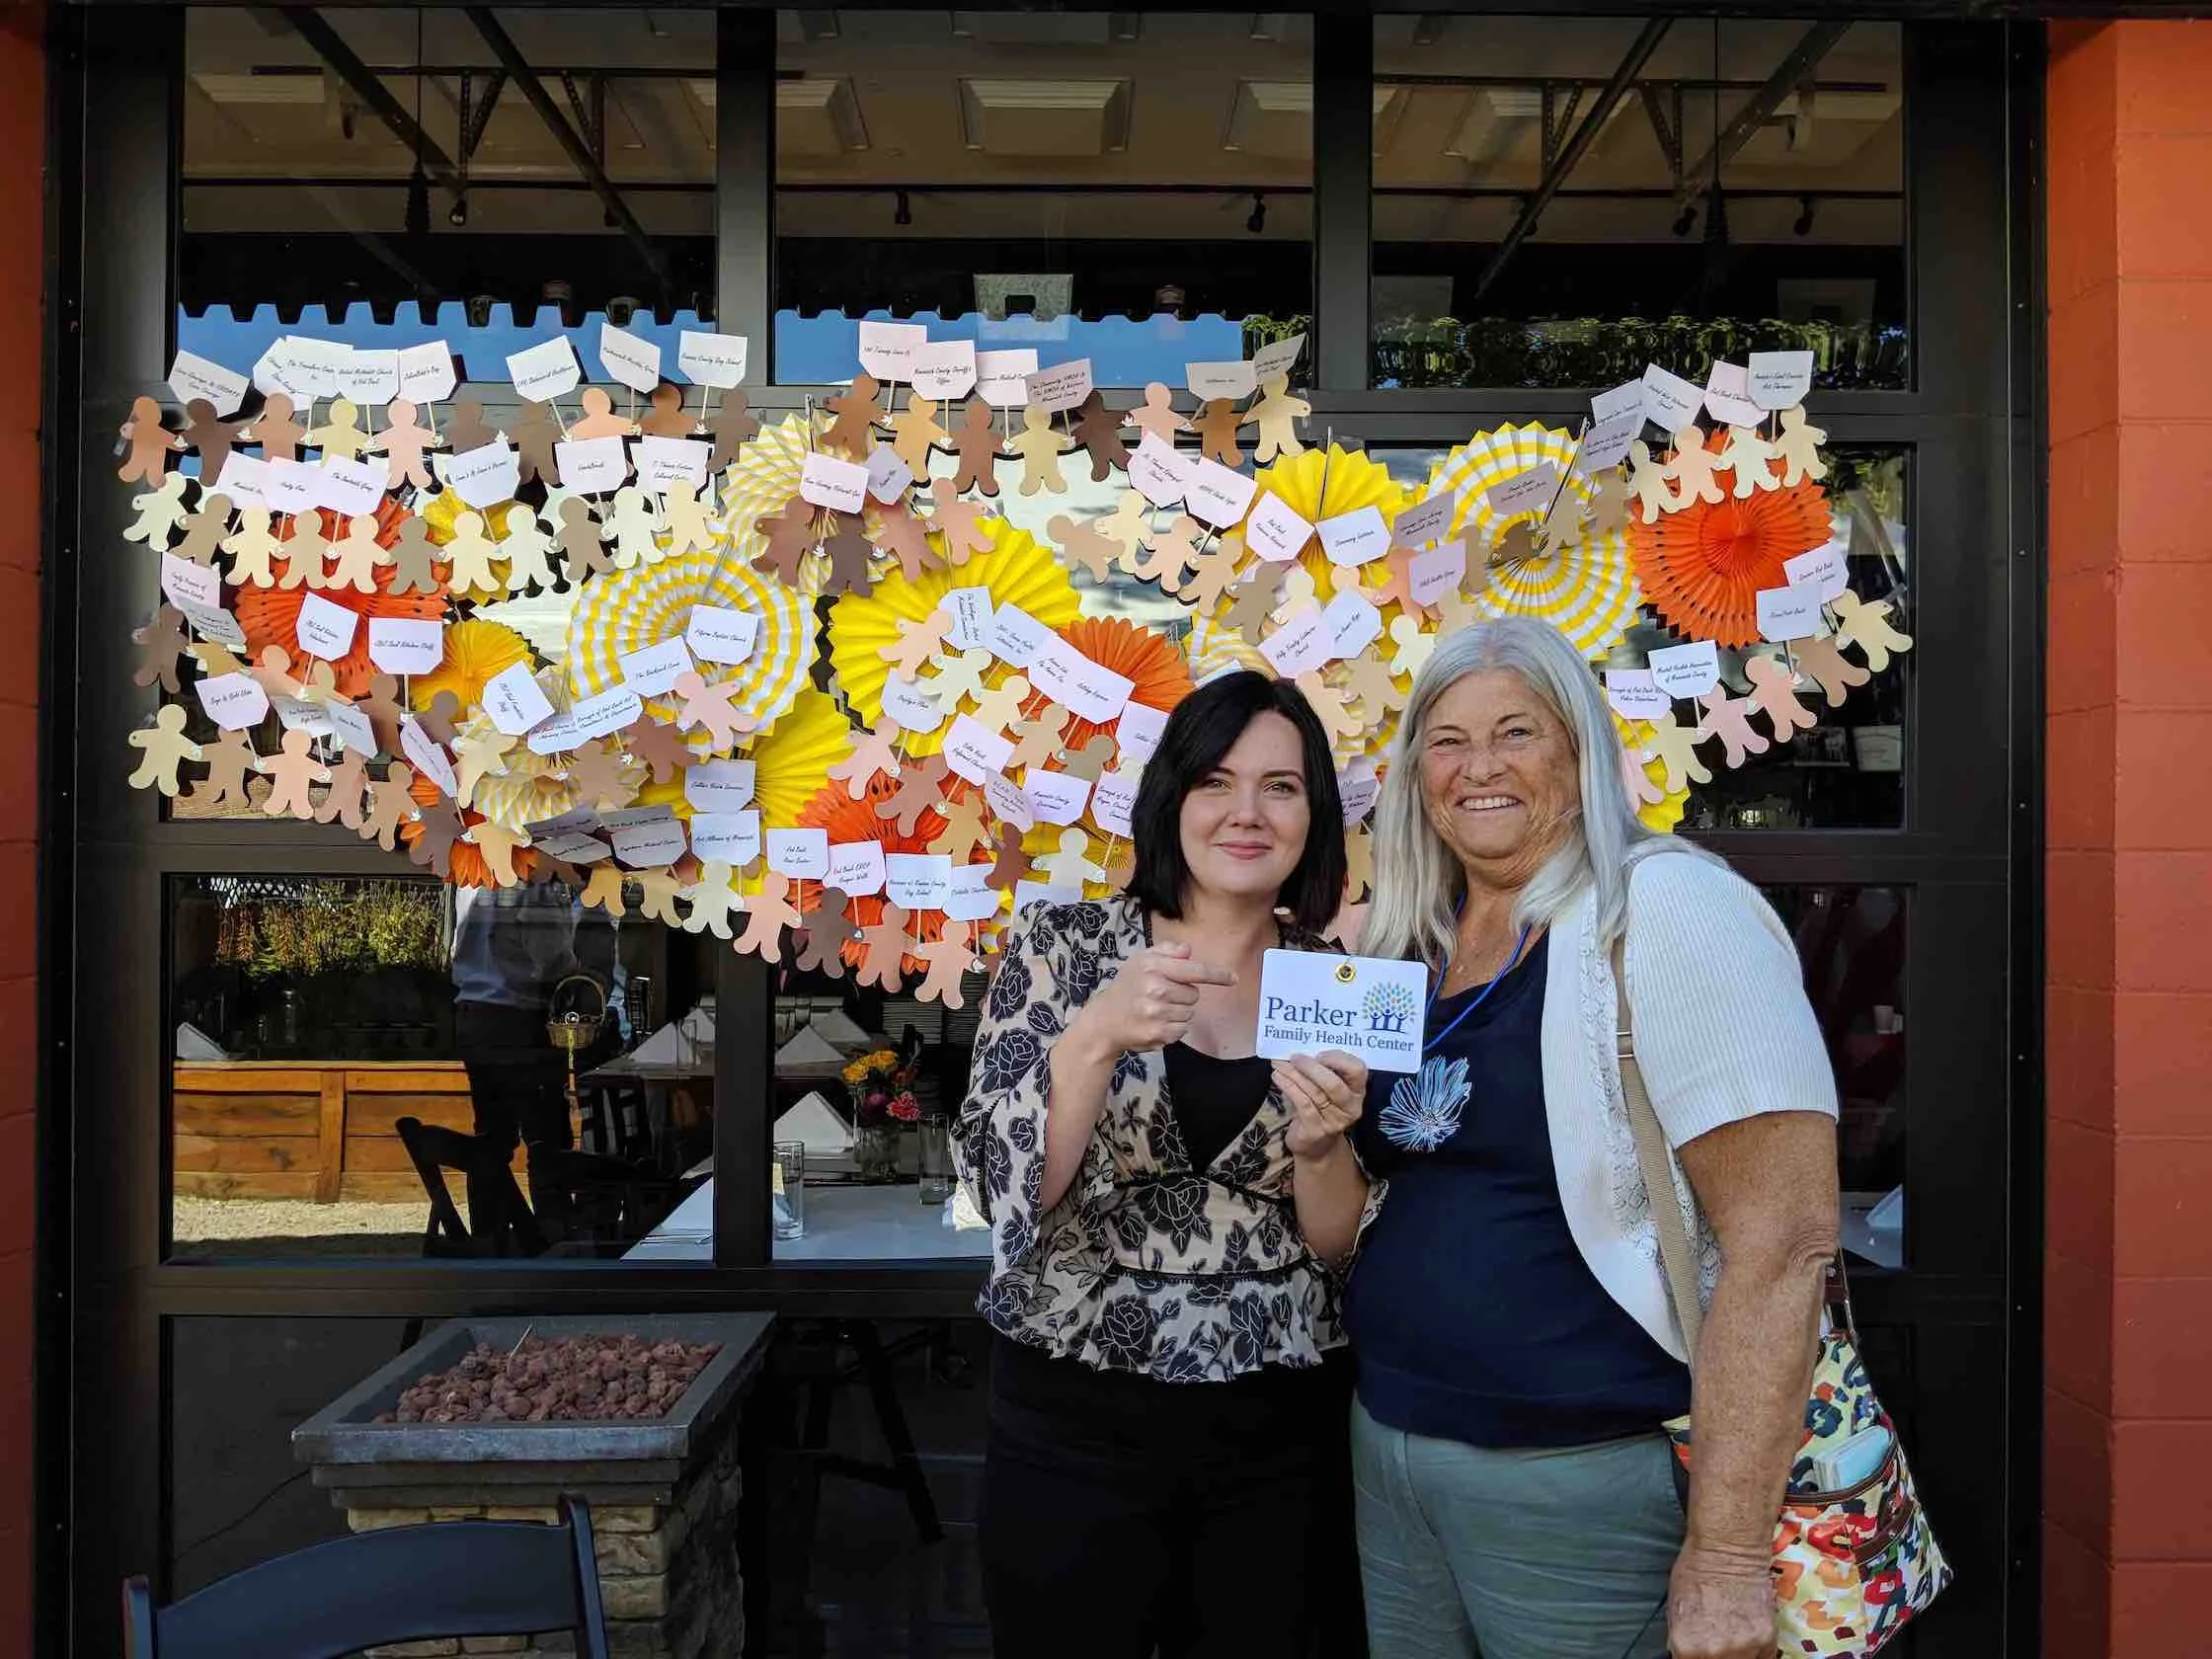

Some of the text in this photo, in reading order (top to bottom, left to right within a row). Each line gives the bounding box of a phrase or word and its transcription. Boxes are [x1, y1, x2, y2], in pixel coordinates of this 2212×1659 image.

[1265, 995, 1360, 1028] Parker
[1264, 1025, 1415, 1052] Family Health Center
